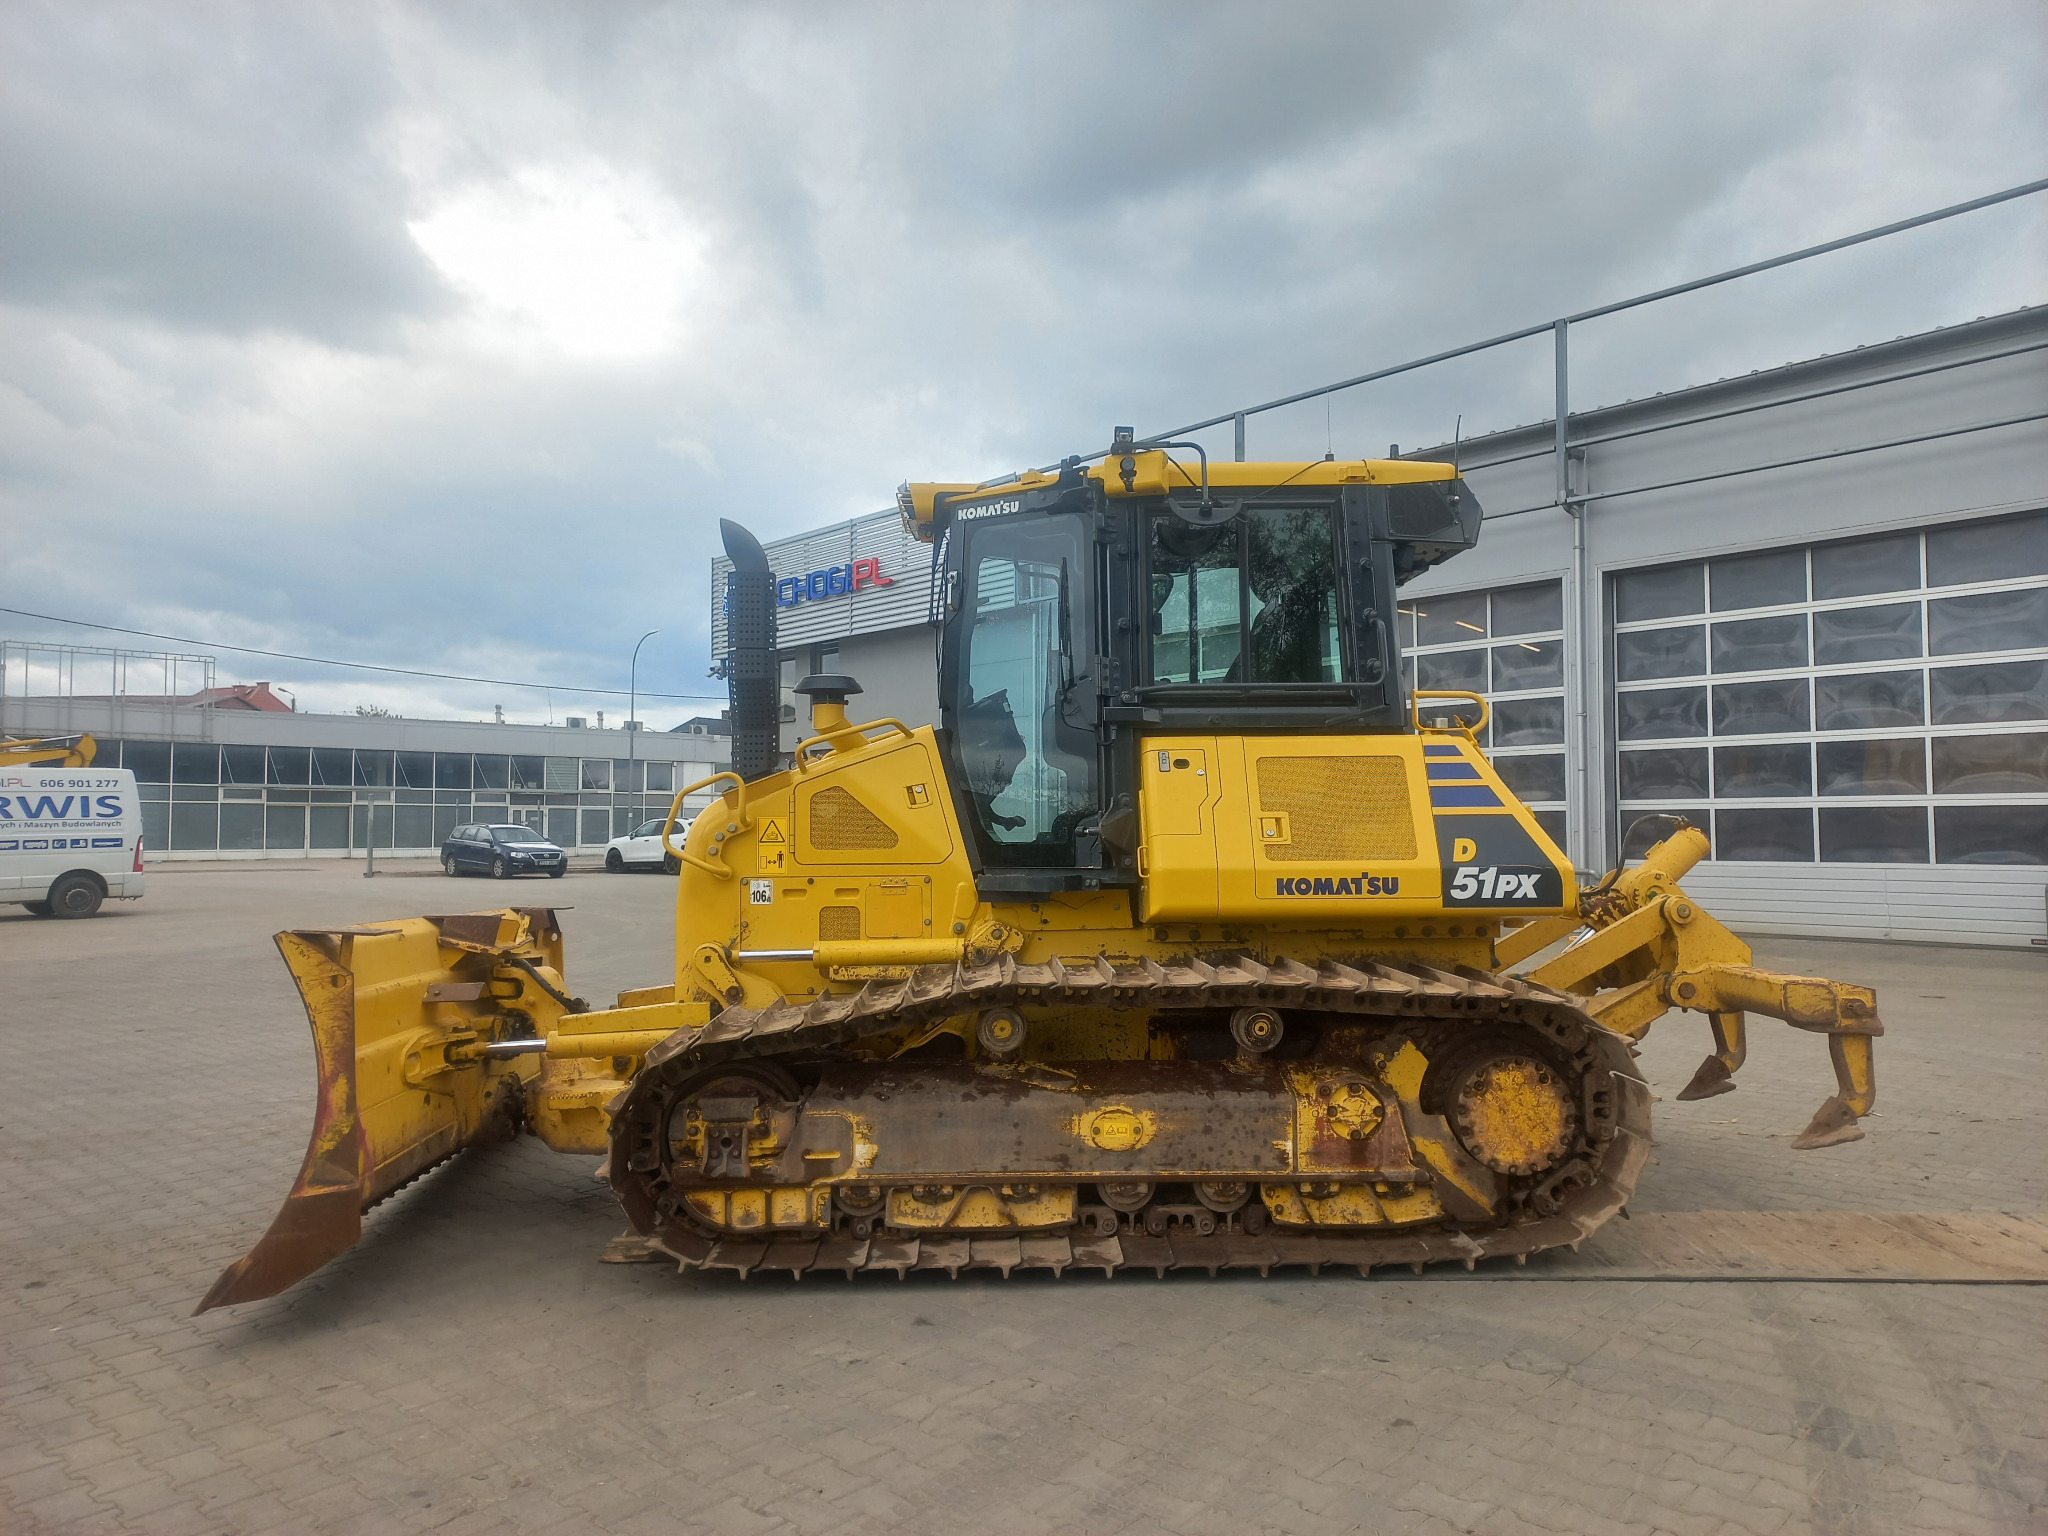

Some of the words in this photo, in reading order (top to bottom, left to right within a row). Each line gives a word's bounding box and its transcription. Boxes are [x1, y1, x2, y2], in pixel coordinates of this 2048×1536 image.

[958, 500, 1019, 520] KOMATSU
[24, 821, 59, 829] Maszyn
[62, 820, 121, 828] Budowlanych
[1453, 838, 1476, 862] D
[1276, 872, 1398, 895] KOMATSU
[1450, 866, 1541, 899] 51PX
